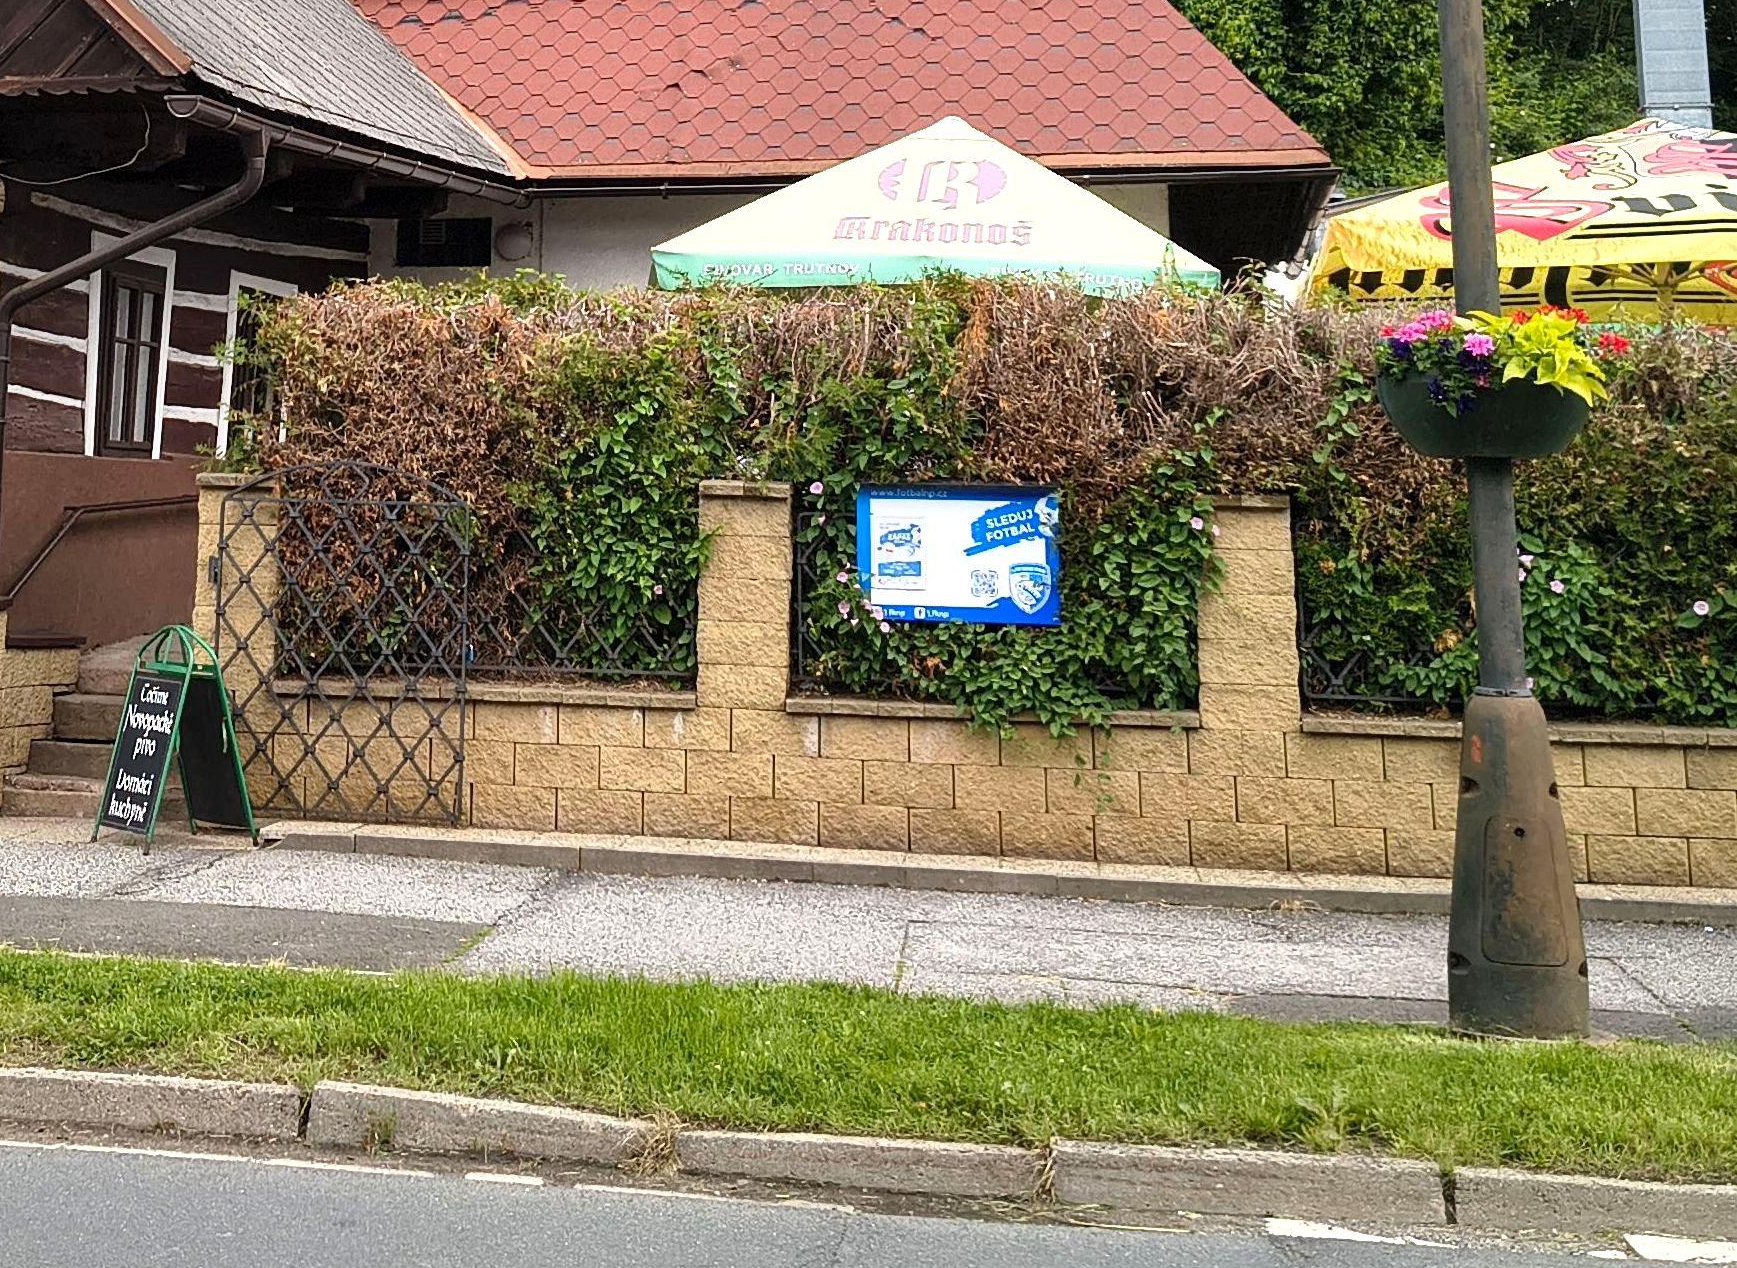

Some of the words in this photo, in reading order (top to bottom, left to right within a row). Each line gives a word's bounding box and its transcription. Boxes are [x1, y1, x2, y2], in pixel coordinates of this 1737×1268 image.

[985, 509, 1033, 529] SLEDUJ
[985, 522, 1036, 543] FOTBAL
[132, 736, 157, 760] pivo
